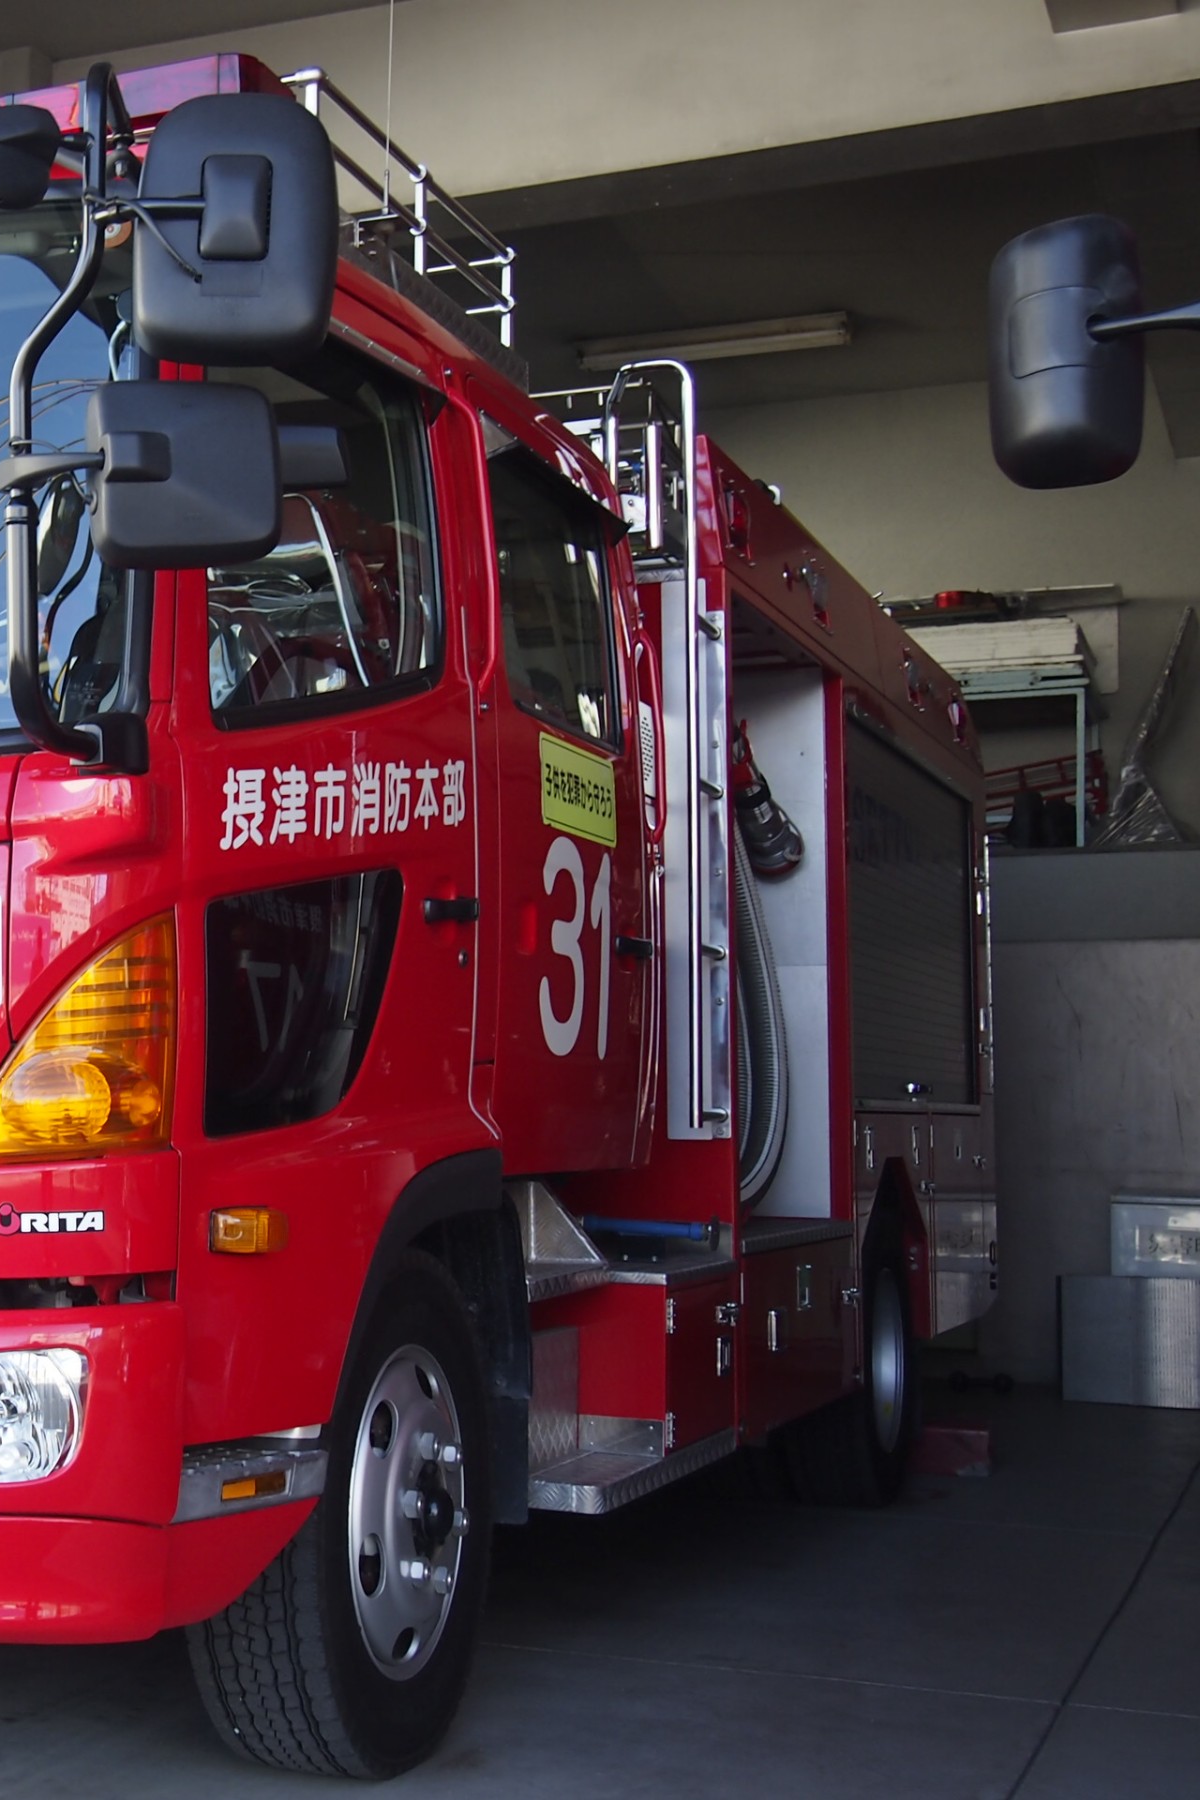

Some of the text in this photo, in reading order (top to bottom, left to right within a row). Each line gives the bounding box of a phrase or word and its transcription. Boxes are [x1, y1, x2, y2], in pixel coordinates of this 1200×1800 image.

[219, 758, 466, 851] 摂津市消防本部
[544, 763, 613, 819] 子供を犯罪から守ろう
[539, 836, 612, 1060] 31
